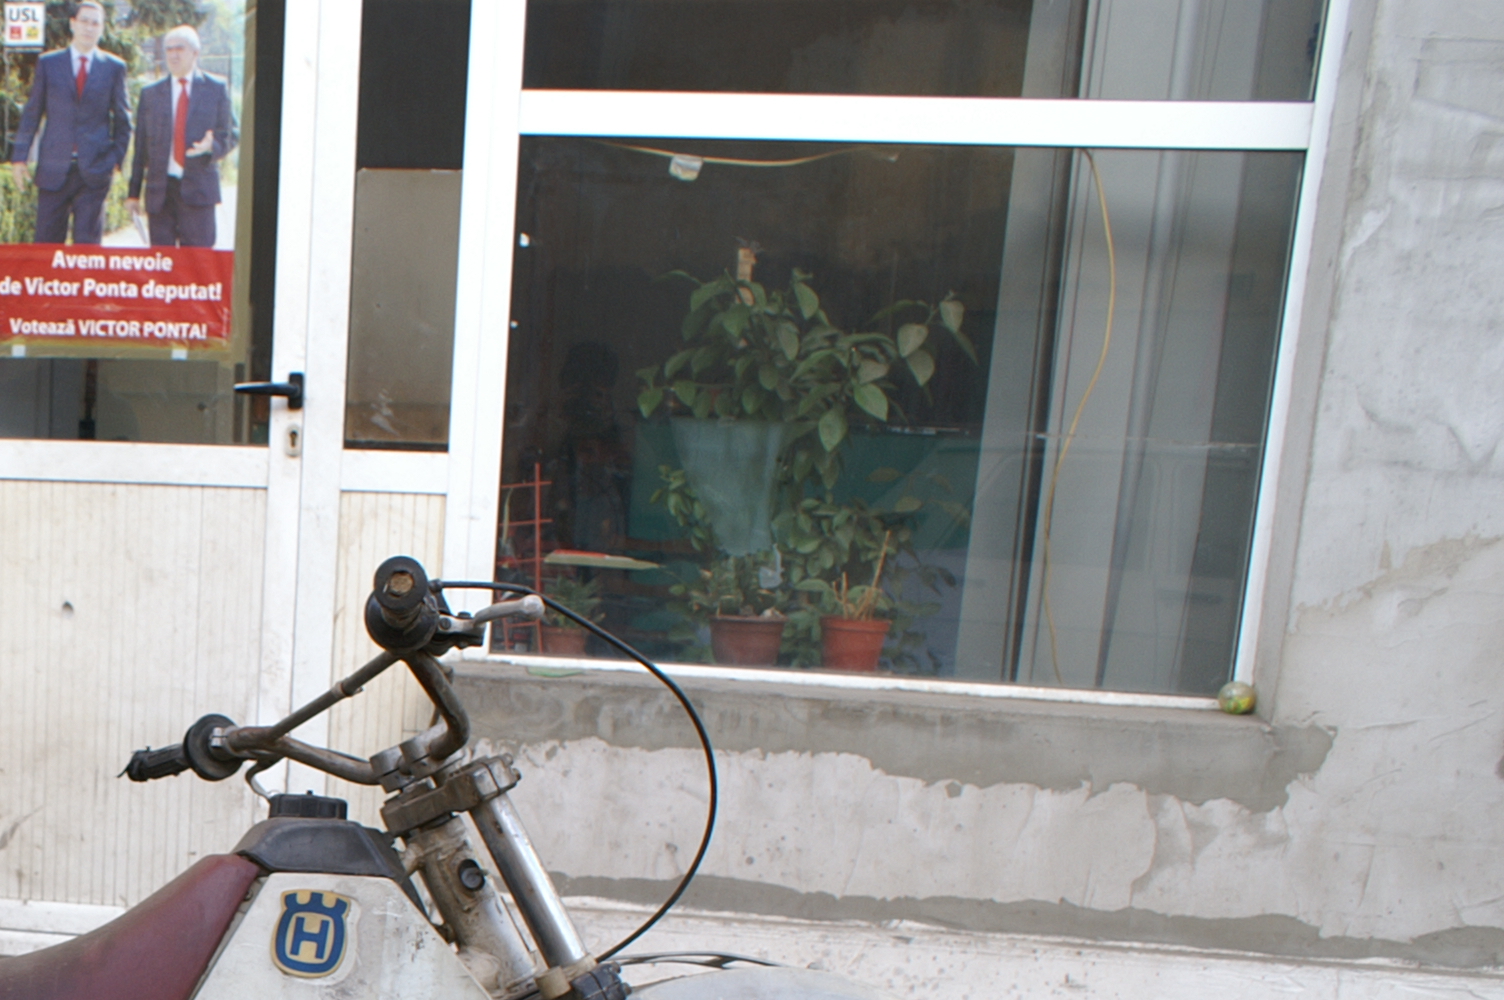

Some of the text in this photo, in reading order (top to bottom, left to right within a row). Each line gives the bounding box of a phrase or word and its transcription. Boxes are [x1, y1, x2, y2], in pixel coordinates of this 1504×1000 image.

[9, 7, 40, 22] USL
[51, 250, 174, 272] Avem nevoie
[24, 276, 81, 297] Victor
[83, 278, 139, 298] Ponta
[141, 279, 223, 304] deputat!
[9, 317, 76, 336] Votează
[78, 319, 141, 337] VICTOR
[143, 321, 208, 340] PONTA!
